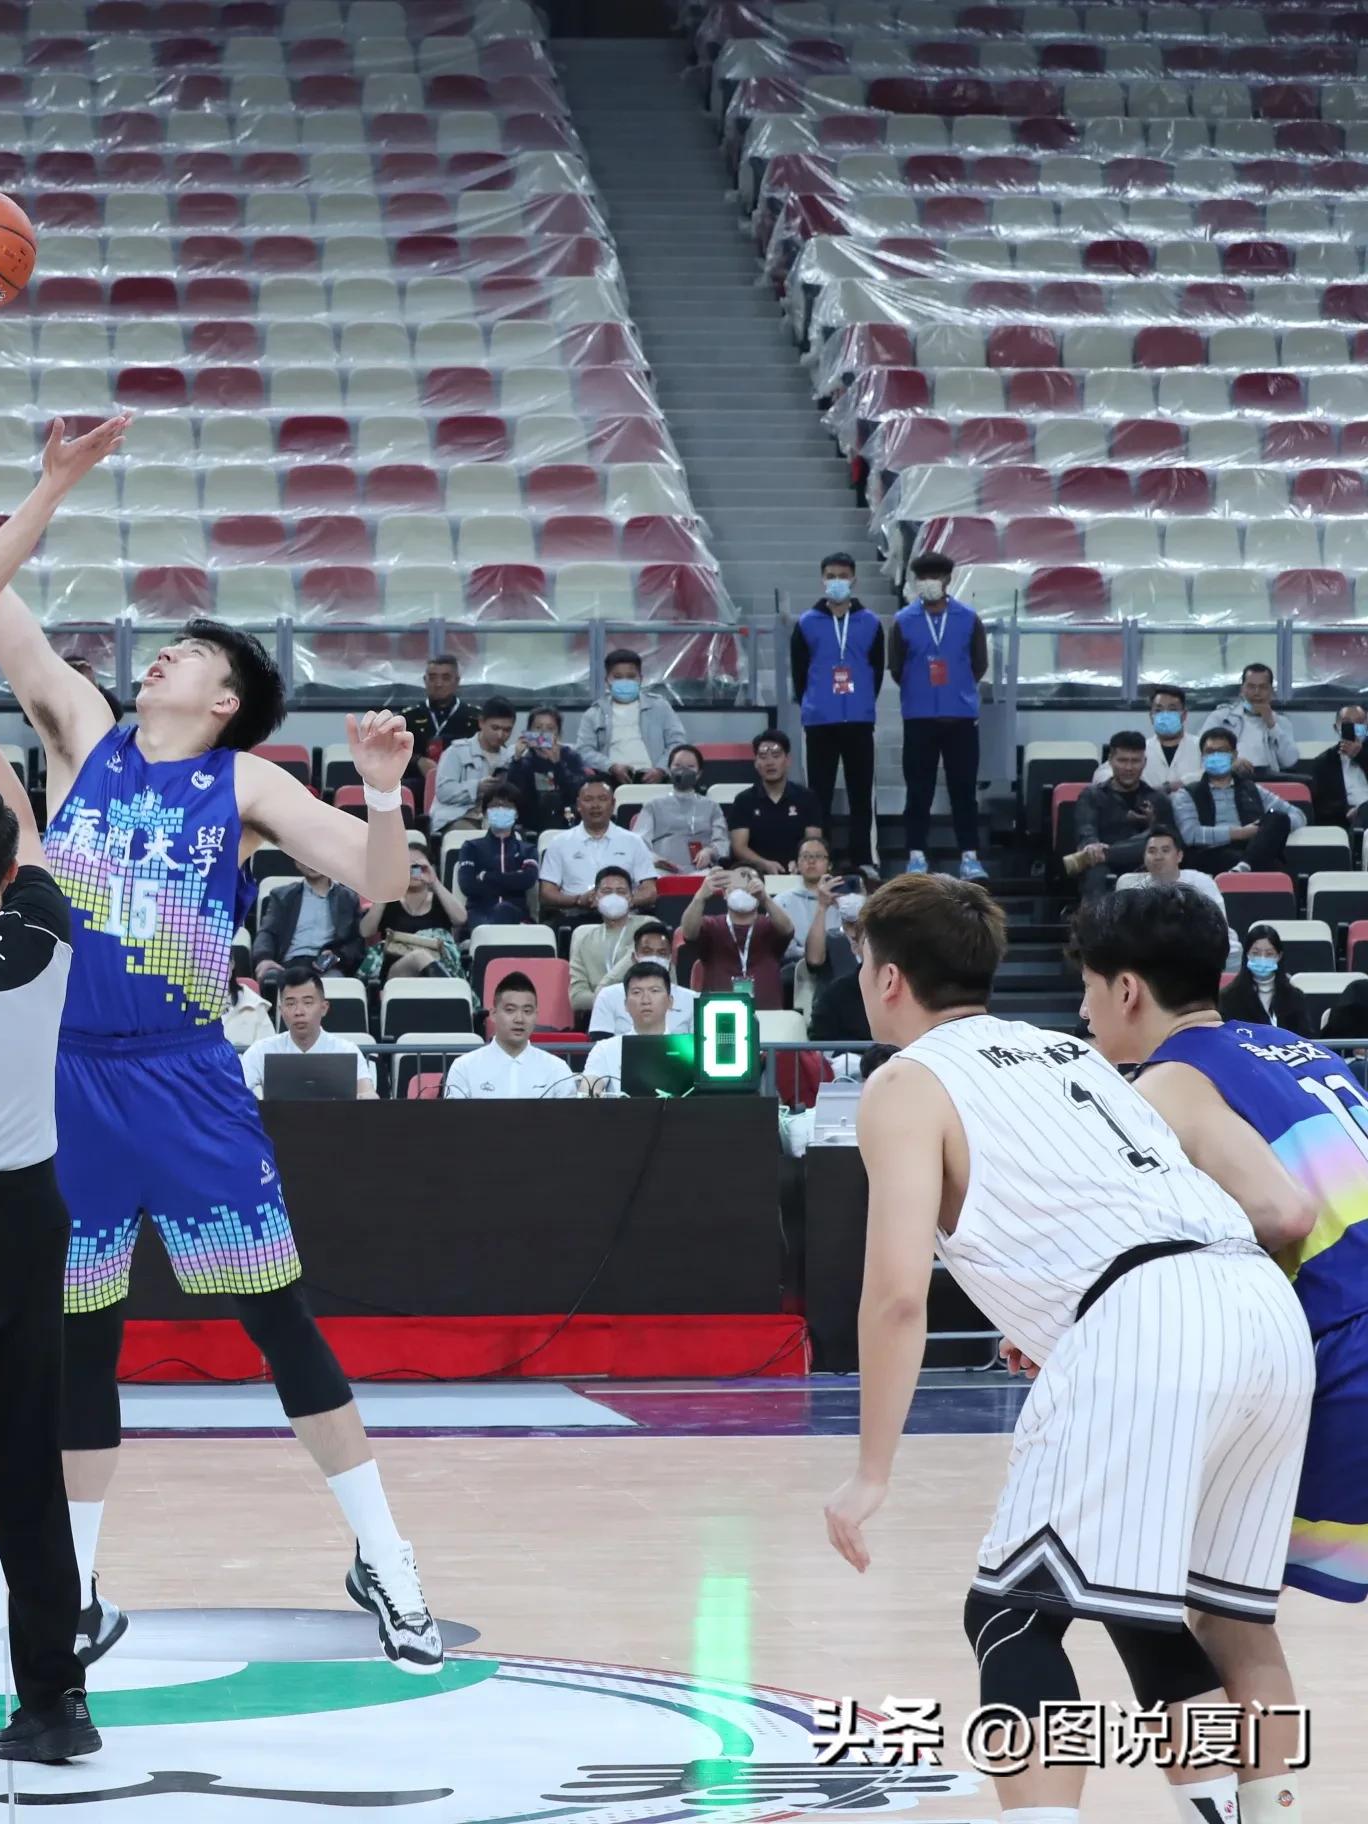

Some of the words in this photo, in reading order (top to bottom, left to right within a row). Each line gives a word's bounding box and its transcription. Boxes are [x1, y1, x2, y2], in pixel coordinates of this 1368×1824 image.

[104, 872, 161, 939] 15
[703, 1000, 748, 1077] 0
[1065, 1078, 1168, 1173] 1
